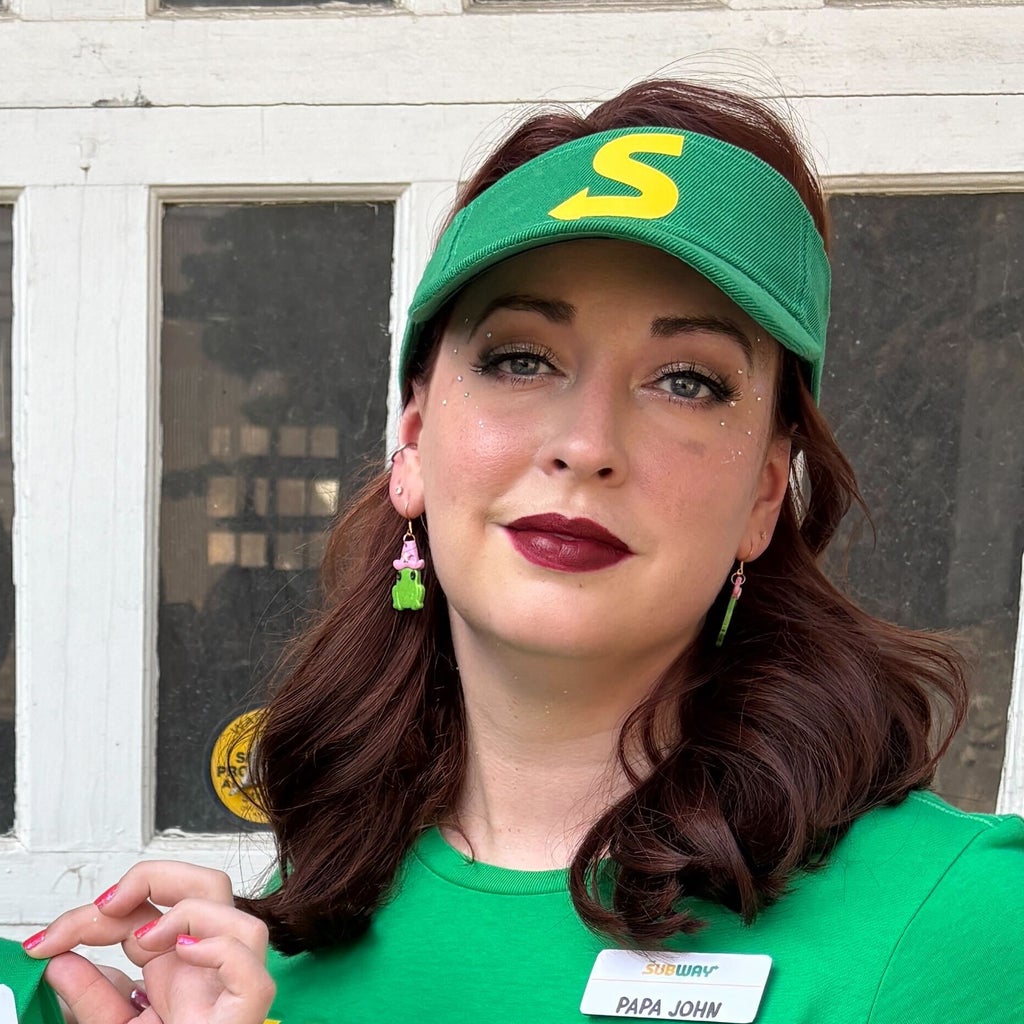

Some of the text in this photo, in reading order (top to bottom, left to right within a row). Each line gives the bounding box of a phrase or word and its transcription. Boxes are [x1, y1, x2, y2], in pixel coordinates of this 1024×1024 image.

[548, 133, 685, 220] S
[641, 963, 720, 978] SUBWAY
[615, 996, 722, 1019] PAPA JOHN
